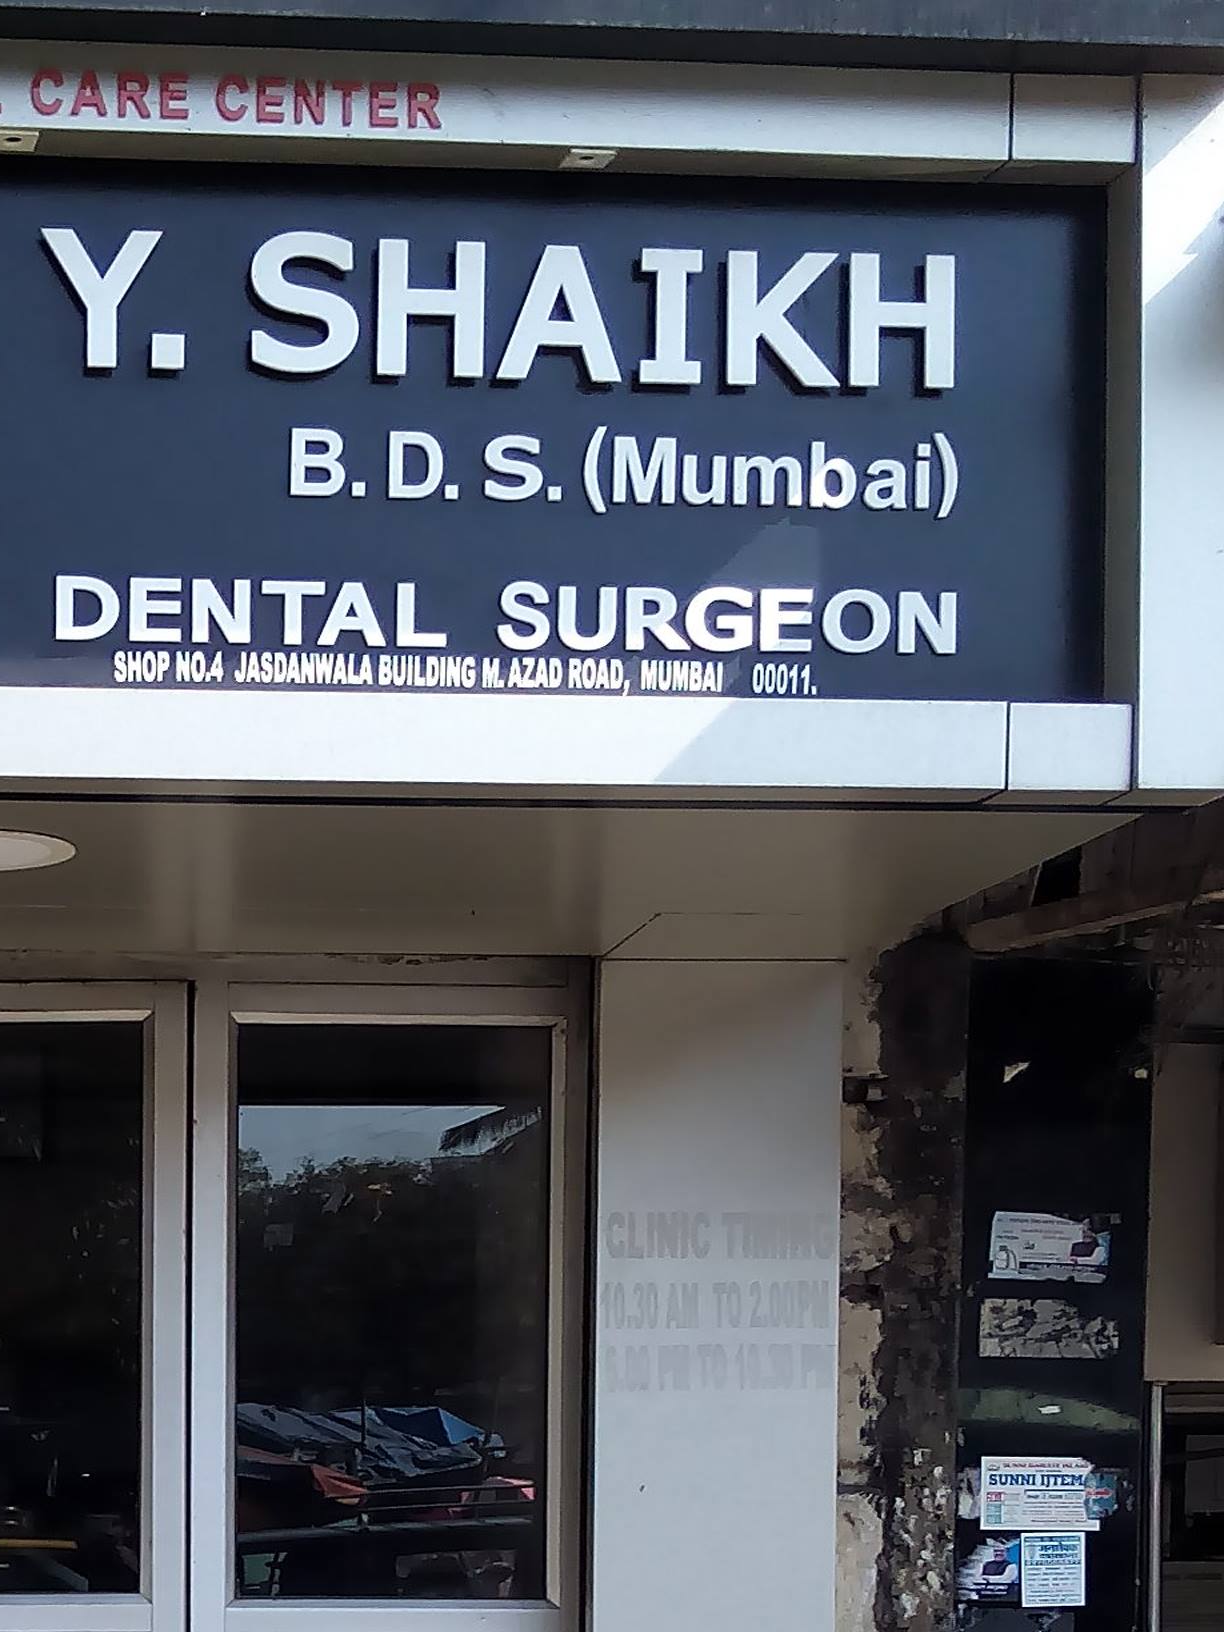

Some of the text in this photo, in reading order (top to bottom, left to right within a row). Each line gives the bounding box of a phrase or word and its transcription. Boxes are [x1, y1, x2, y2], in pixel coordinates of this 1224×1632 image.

[30, 68, 190, 120] CARE
[214, 73, 443, 130] CENTER
[41, 228, 185, 372] Y.
[248, 231, 957, 391] SHAIKH
[584, 426, 959, 518] (Mumbai)
[55, 575, 958, 655] DENTAL SURGEON
[113, 651, 170, 683] SHOP
[176, 651, 224, 682] NO.4
[234, 652, 374, 686] JASDANWALA
[378, 655, 477, 688] BUILDING
[507, 658, 562, 688] AZAD
[568, 659, 631, 696] ROAD,
[640, 660, 724, 692] MUMBAI
[606, 1211, 710, 1259] CLINIC
[601, 1281, 658, 1329] 10.30
[666, 1281, 699, 1329] AM
[712, 1281, 742, 1329] TO
[989, 1473, 1036, 1486] SUNNI
